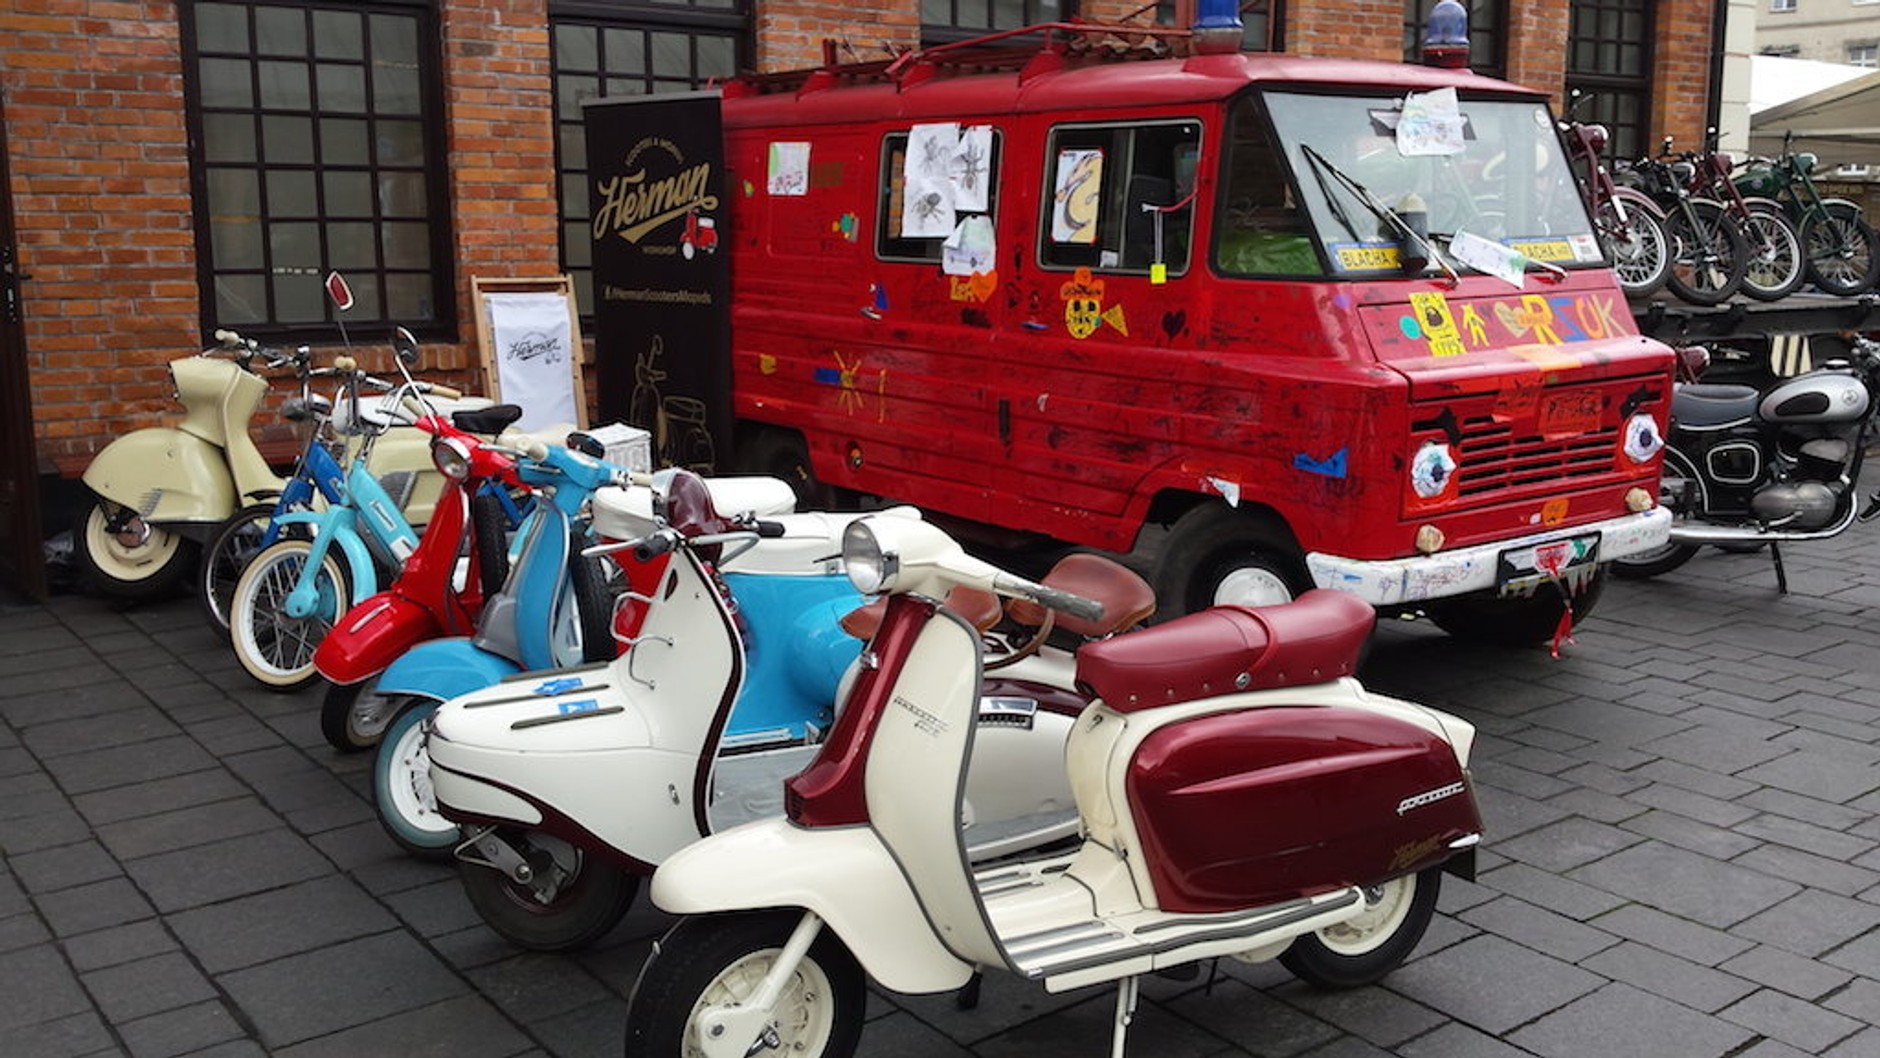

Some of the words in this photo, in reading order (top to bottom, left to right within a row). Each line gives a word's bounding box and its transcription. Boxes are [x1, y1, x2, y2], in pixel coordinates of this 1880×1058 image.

[593, 162, 719, 240] Herman
[1341, 250, 1392, 268] BLACHA
[507, 338, 561, 361] Herman
